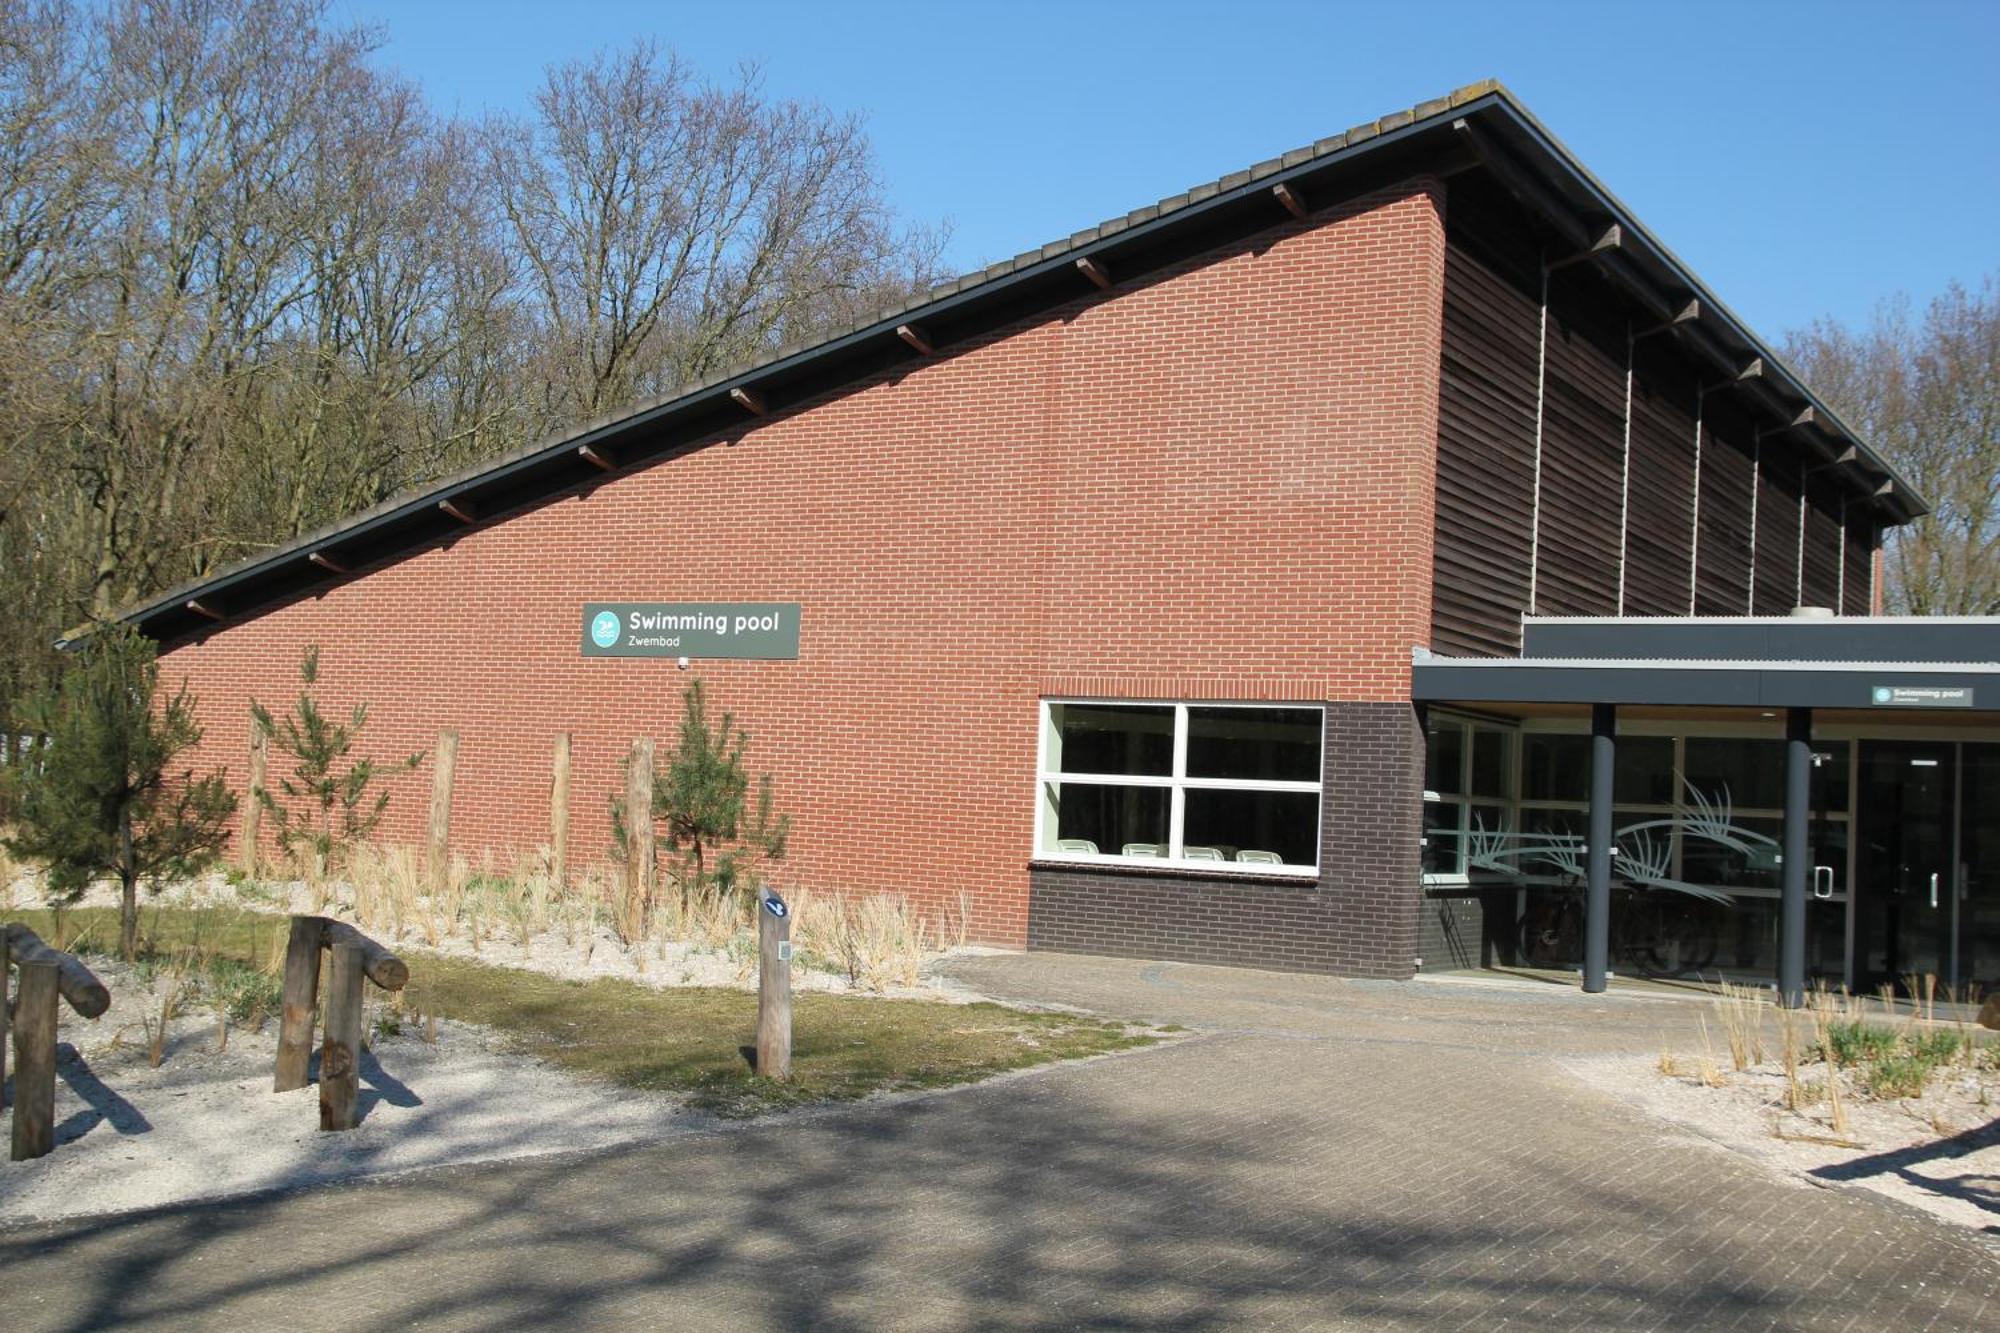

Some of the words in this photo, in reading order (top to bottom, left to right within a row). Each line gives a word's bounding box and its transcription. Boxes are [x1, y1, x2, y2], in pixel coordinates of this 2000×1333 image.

[629, 611, 727, 635] Swimming
[734, 612, 779, 635] pool
[628, 635, 680, 647] Zwembad
[1893, 688, 1940, 699] Swimming
[1942, 689, 1964, 699] pool
